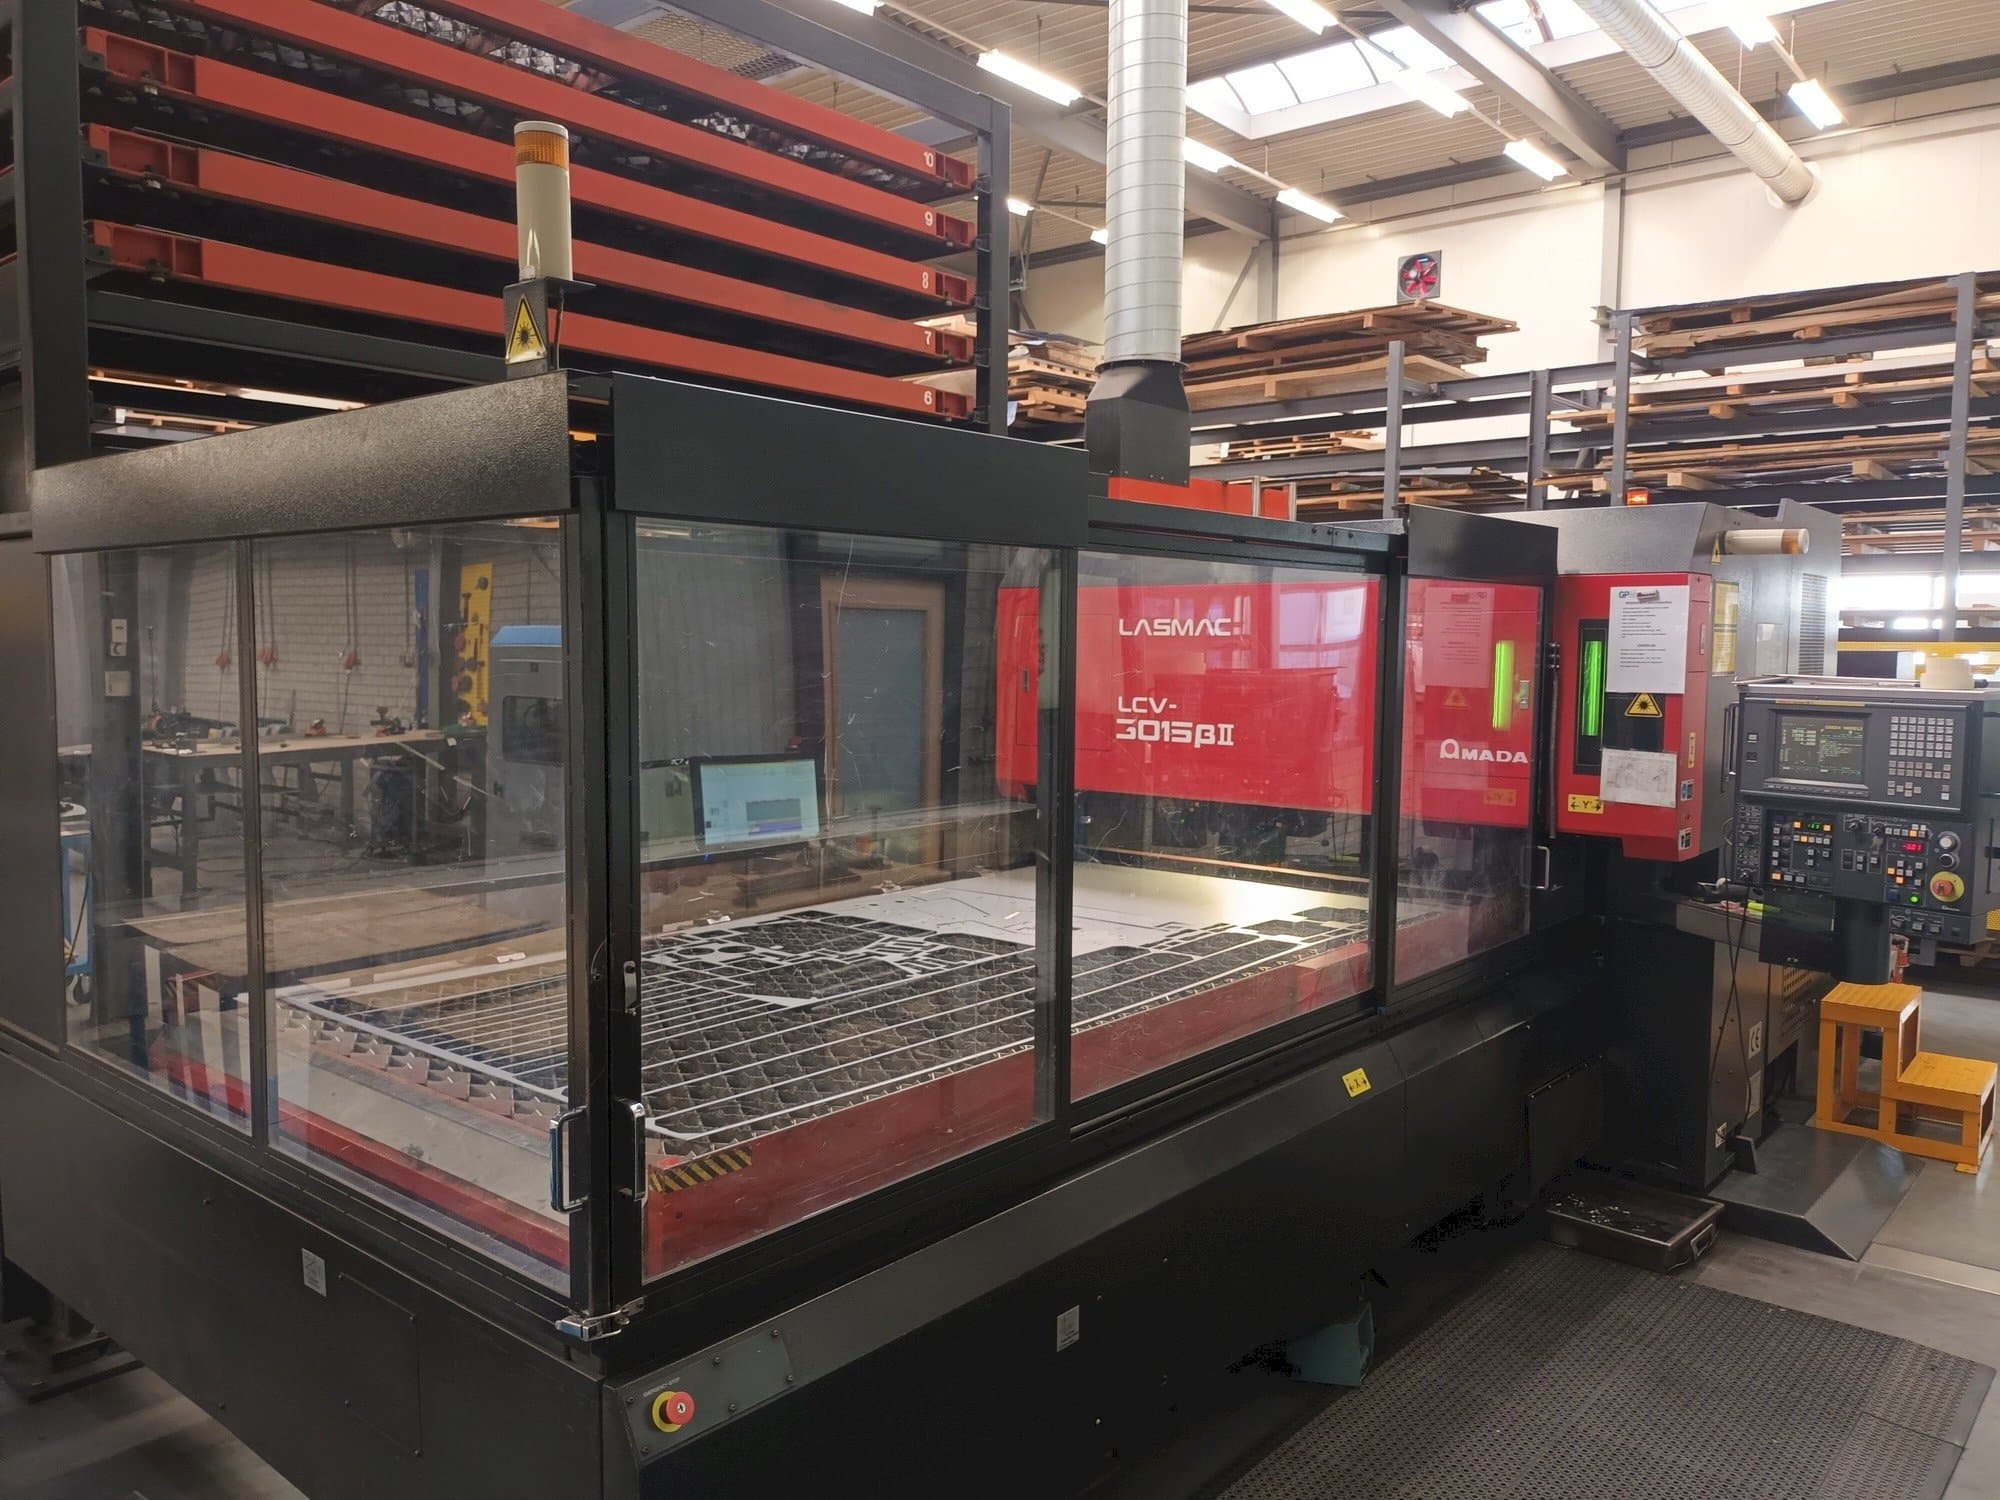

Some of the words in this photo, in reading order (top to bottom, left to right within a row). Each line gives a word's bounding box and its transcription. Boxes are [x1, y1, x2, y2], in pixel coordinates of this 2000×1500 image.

[923, 151, 934, 167] 10
[924, 211, 933, 227] 9
[921, 271, 929, 289] 8
[924, 331, 933, 346] 7
[924, 391, 932, 404] 6
[1119, 618, 1232, 636] LASMAC
[1118, 696, 1177, 714] LCV-
[1440, 738, 1528, 763] AMADA
